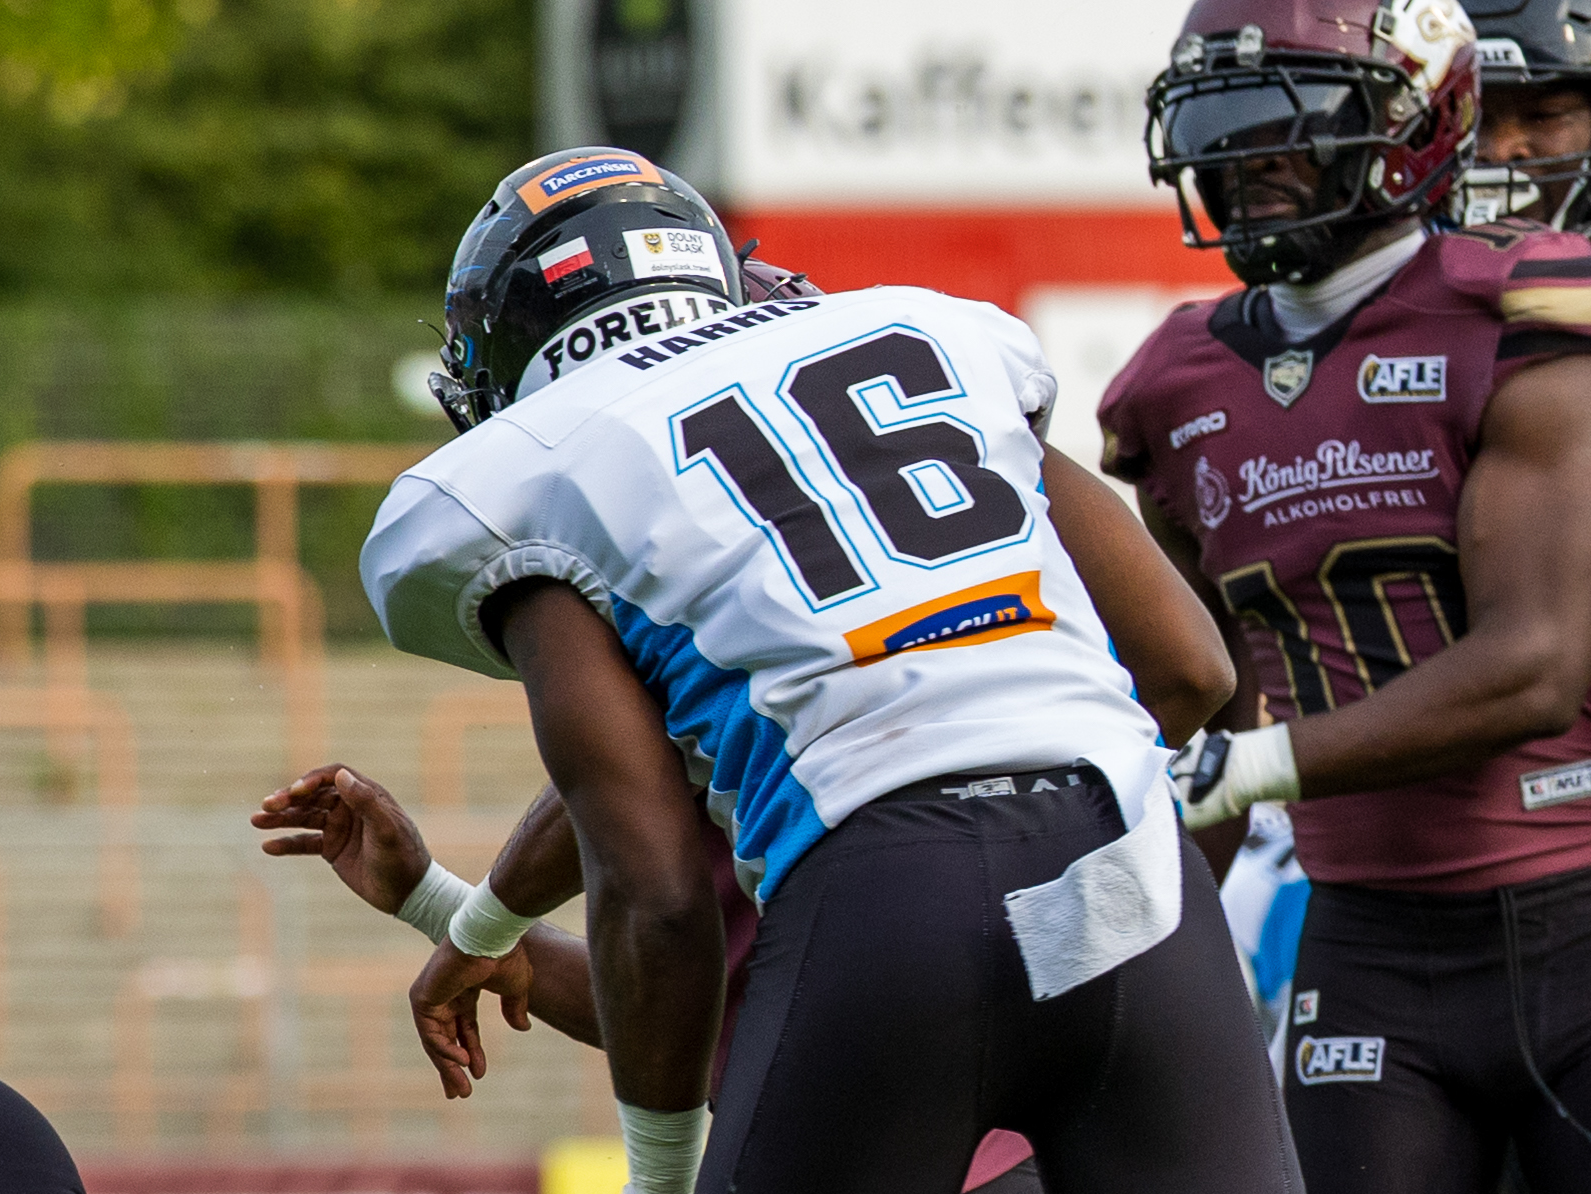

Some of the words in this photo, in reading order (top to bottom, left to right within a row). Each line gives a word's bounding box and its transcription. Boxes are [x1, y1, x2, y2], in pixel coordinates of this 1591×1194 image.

[544, 162, 638, 191] TARCZYŃSKI
[667, 232, 703, 244] DOLNY
[618, 300, 820, 371] HARRIS
[1369, 361, 1441, 393] AFLE
[669, 323, 1033, 612] 16
[1264, 488, 1427, 528] ALKOHOLFREI
[1306, 1042, 1377, 1075] AFLE
